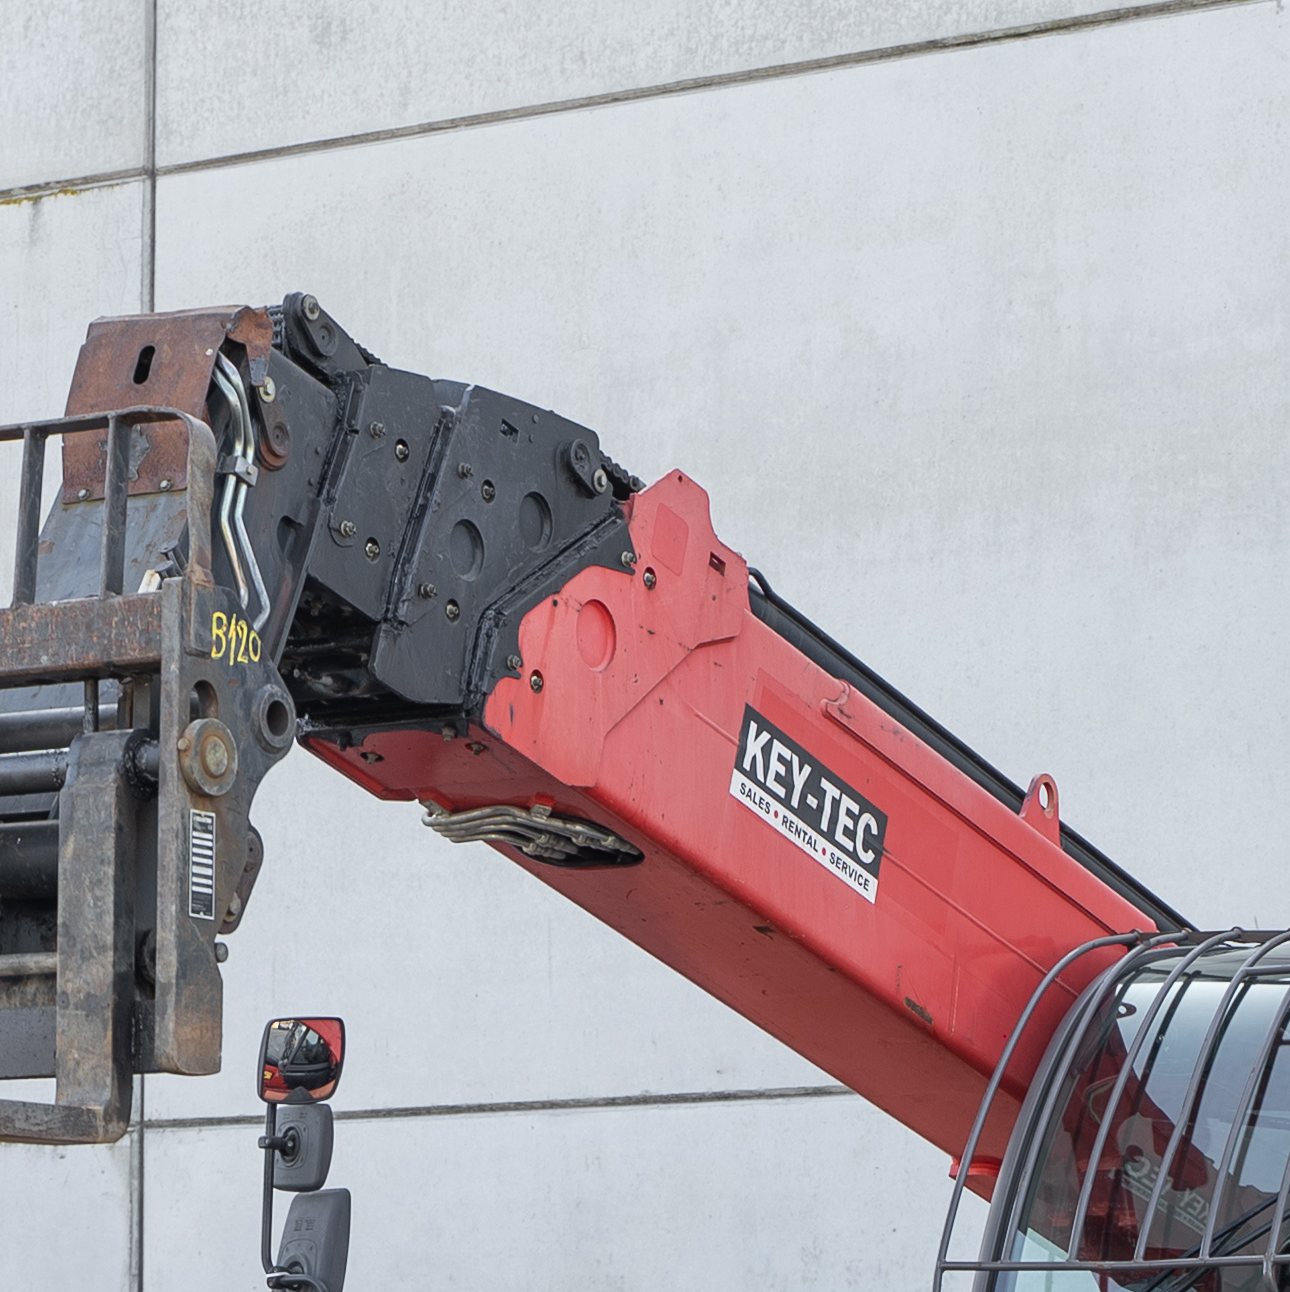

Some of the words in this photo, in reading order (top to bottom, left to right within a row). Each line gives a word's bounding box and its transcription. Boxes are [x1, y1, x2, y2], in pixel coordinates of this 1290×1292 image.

[211, 611, 261, 666] B120
[739, 782, 771, 815] SALES
[781, 815, 819, 853] RENTAL
[829, 852, 870, 891] SERVICE
[743, 720, 878, 864] KEY-TEC
